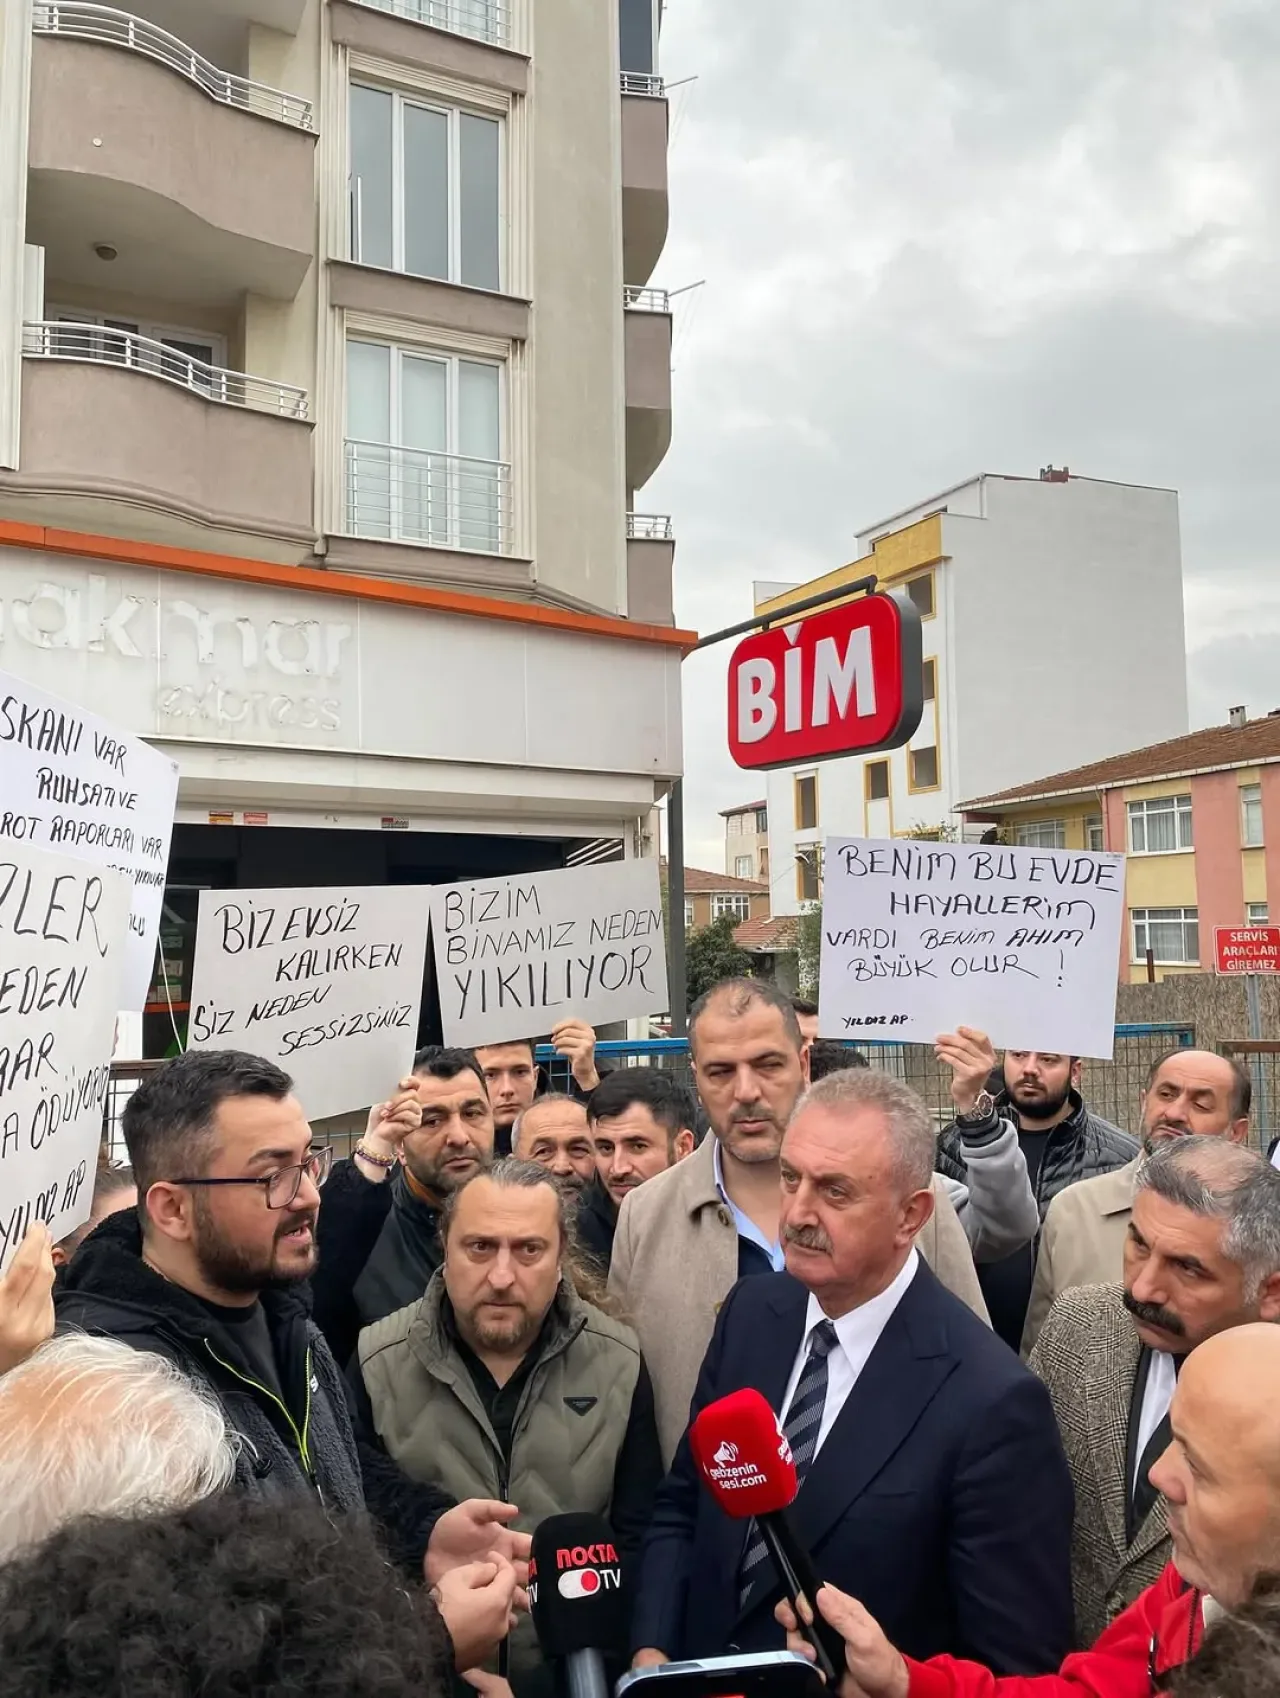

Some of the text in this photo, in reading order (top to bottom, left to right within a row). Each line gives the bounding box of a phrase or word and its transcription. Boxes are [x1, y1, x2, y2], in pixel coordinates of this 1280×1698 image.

[737, 621, 877, 744] BİM
[94, 731, 128, 777] VAR
[49, 815, 134, 853] RAPORLARI
[141, 836, 163, 861] VAR
[968, 851, 1018, 881] BU
[1028, 856, 1120, 892] EVDE
[214, 897, 362, 954] BİZ EVSİZ
[444, 881, 541, 933] BİZİM
[446, 909, 664, 965] BİNAMIZ NEDEN
[826, 928, 897, 950] VARDI
[1005, 928, 1084, 948] AHIM
[1222, 945, 1278, 958] ARAÇLARI
[1230, 929, 1269, 942] SERVİS
[275, 943, 403, 982] KALIRKEN
[454, 945, 656, 1020] YIKILIYOR
[847, 954, 938, 981] BÜYÜK
[951, 954, 1040, 980] OLUR
[1226, 958, 1277, 970] GİREMEZ
[193, 984, 332, 1042] SİZ NEDEN
[277, 1003, 413, 1057] SESSİZSİNİZ
[61, 1159, 86, 1212] AP
[709, 1463, 758, 1480] gebzenin
[719, 1473, 768, 1489] sesi.com
[600, 1568, 621, 1590] TV
